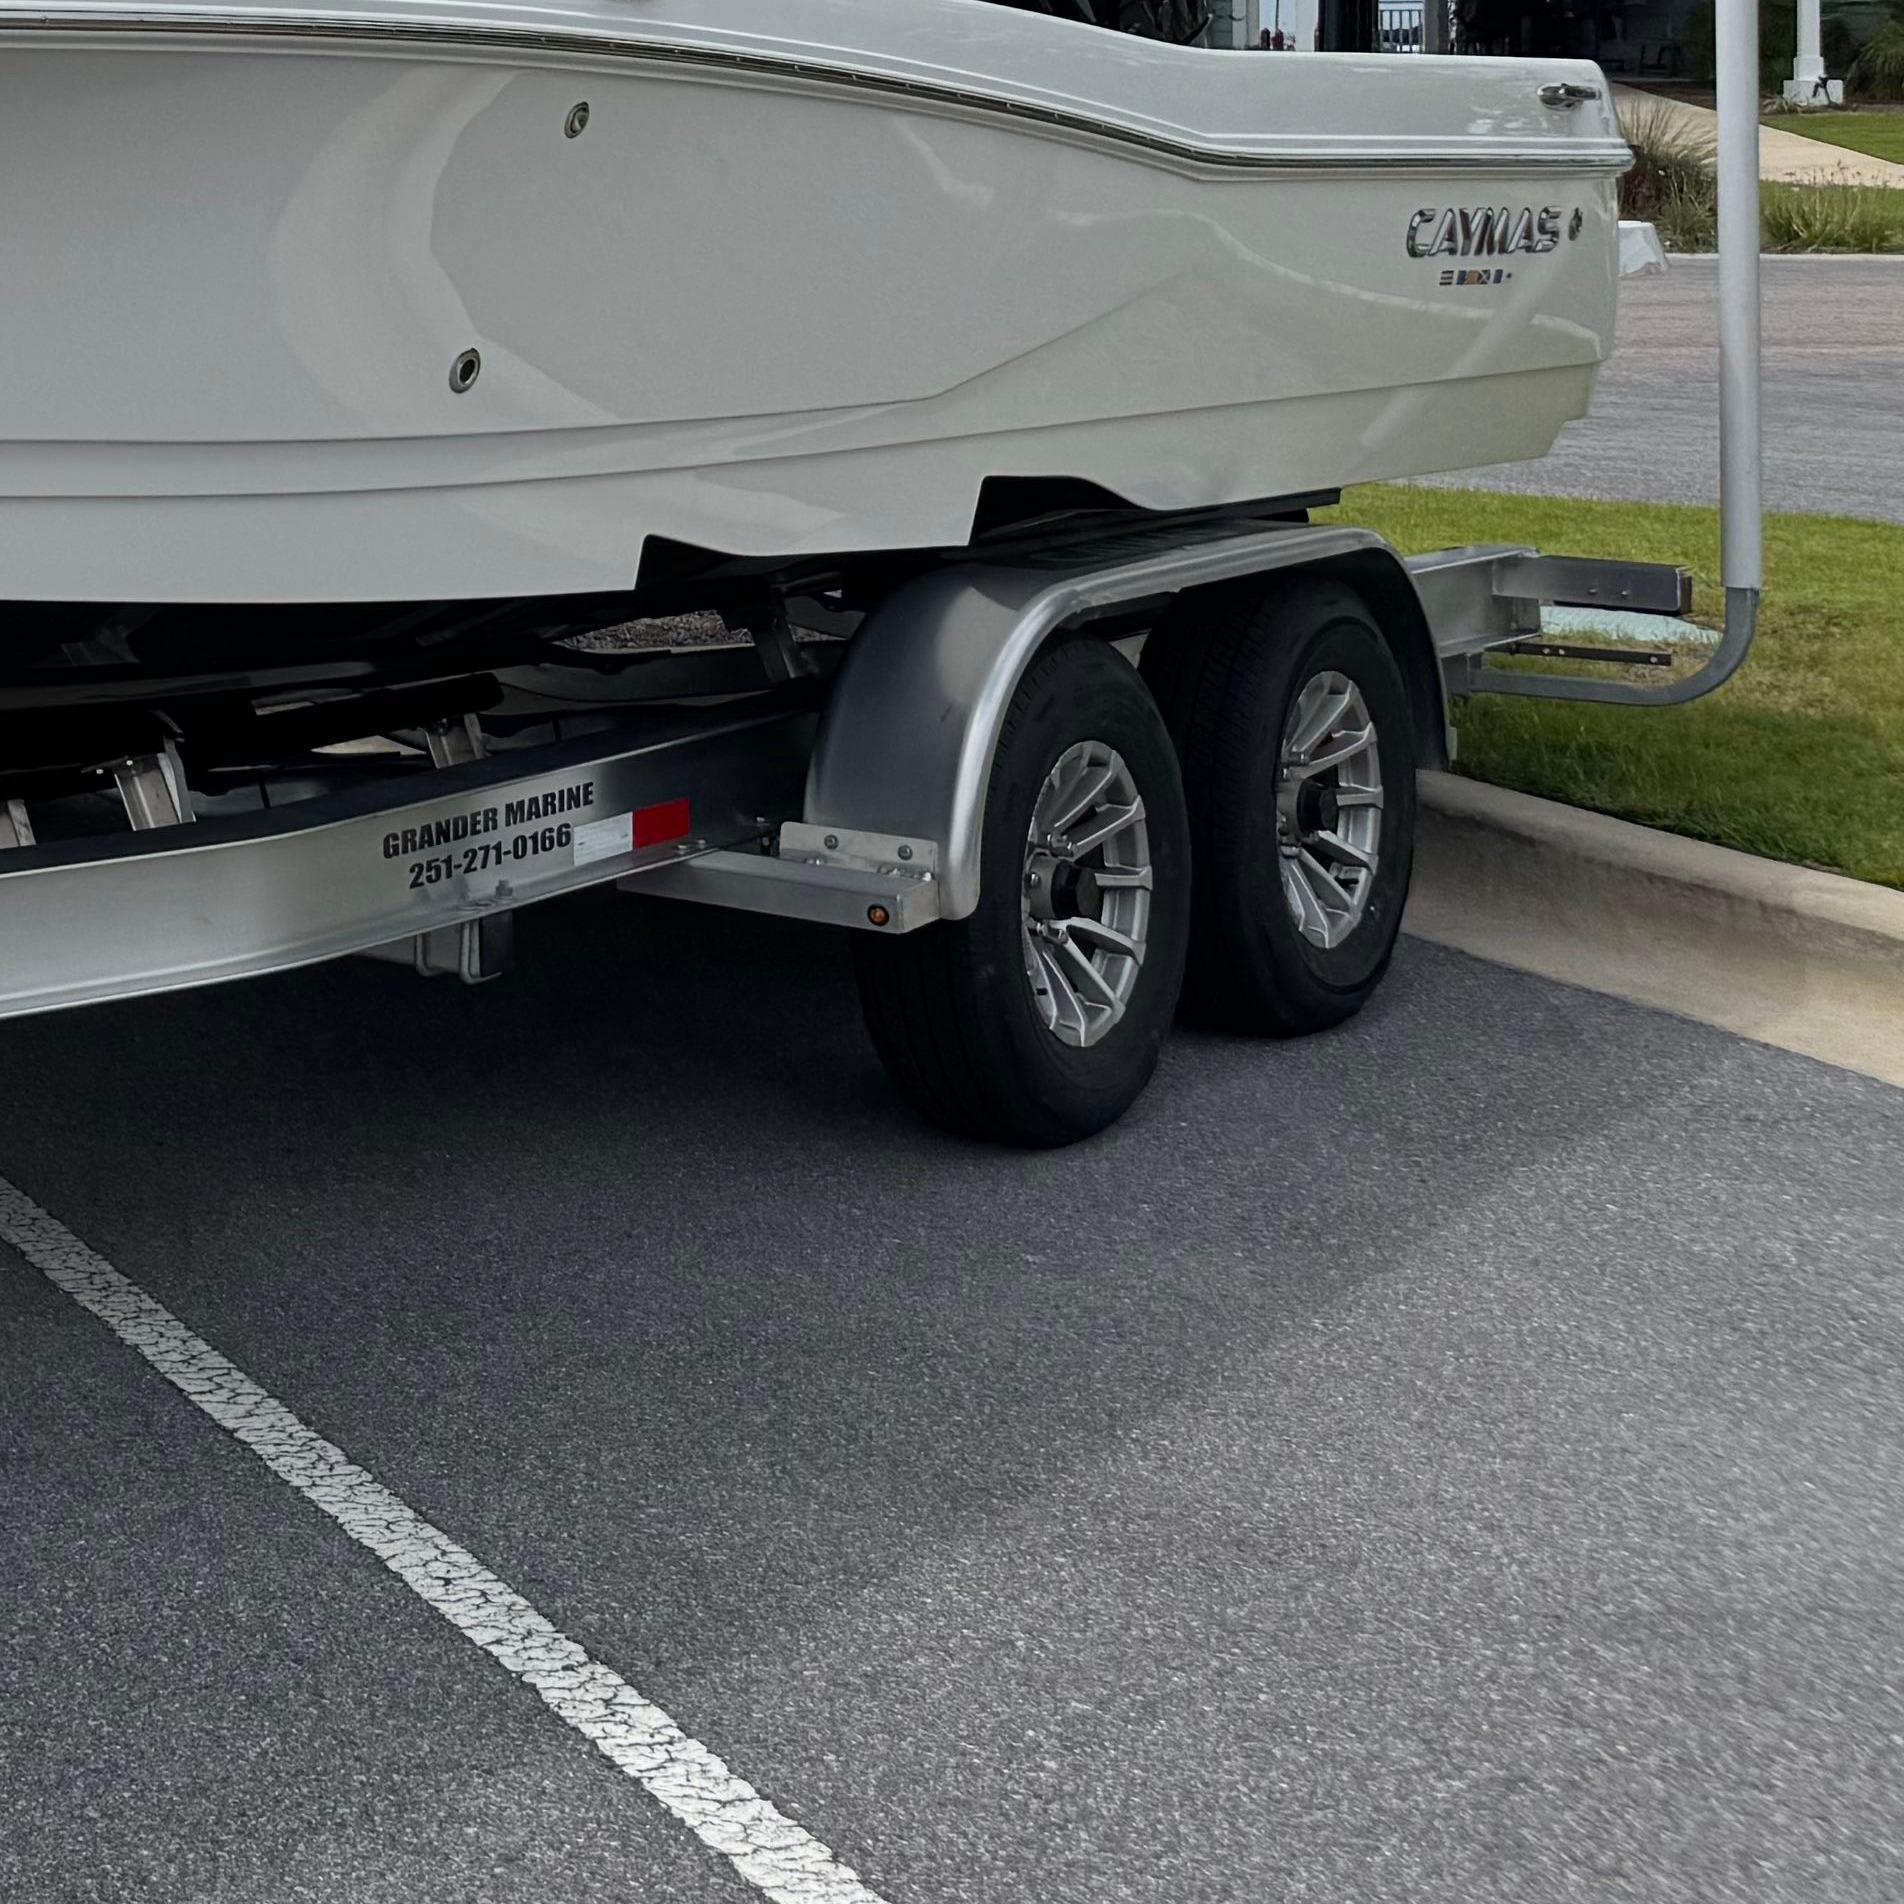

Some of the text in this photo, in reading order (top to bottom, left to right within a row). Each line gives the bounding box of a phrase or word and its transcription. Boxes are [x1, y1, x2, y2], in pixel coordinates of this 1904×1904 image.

[1406, 206, 1562, 258] CAYMAS
[383, 782, 594, 859] GRANDER MARINE
[409, 822, 571, 889] 251-271-0166
